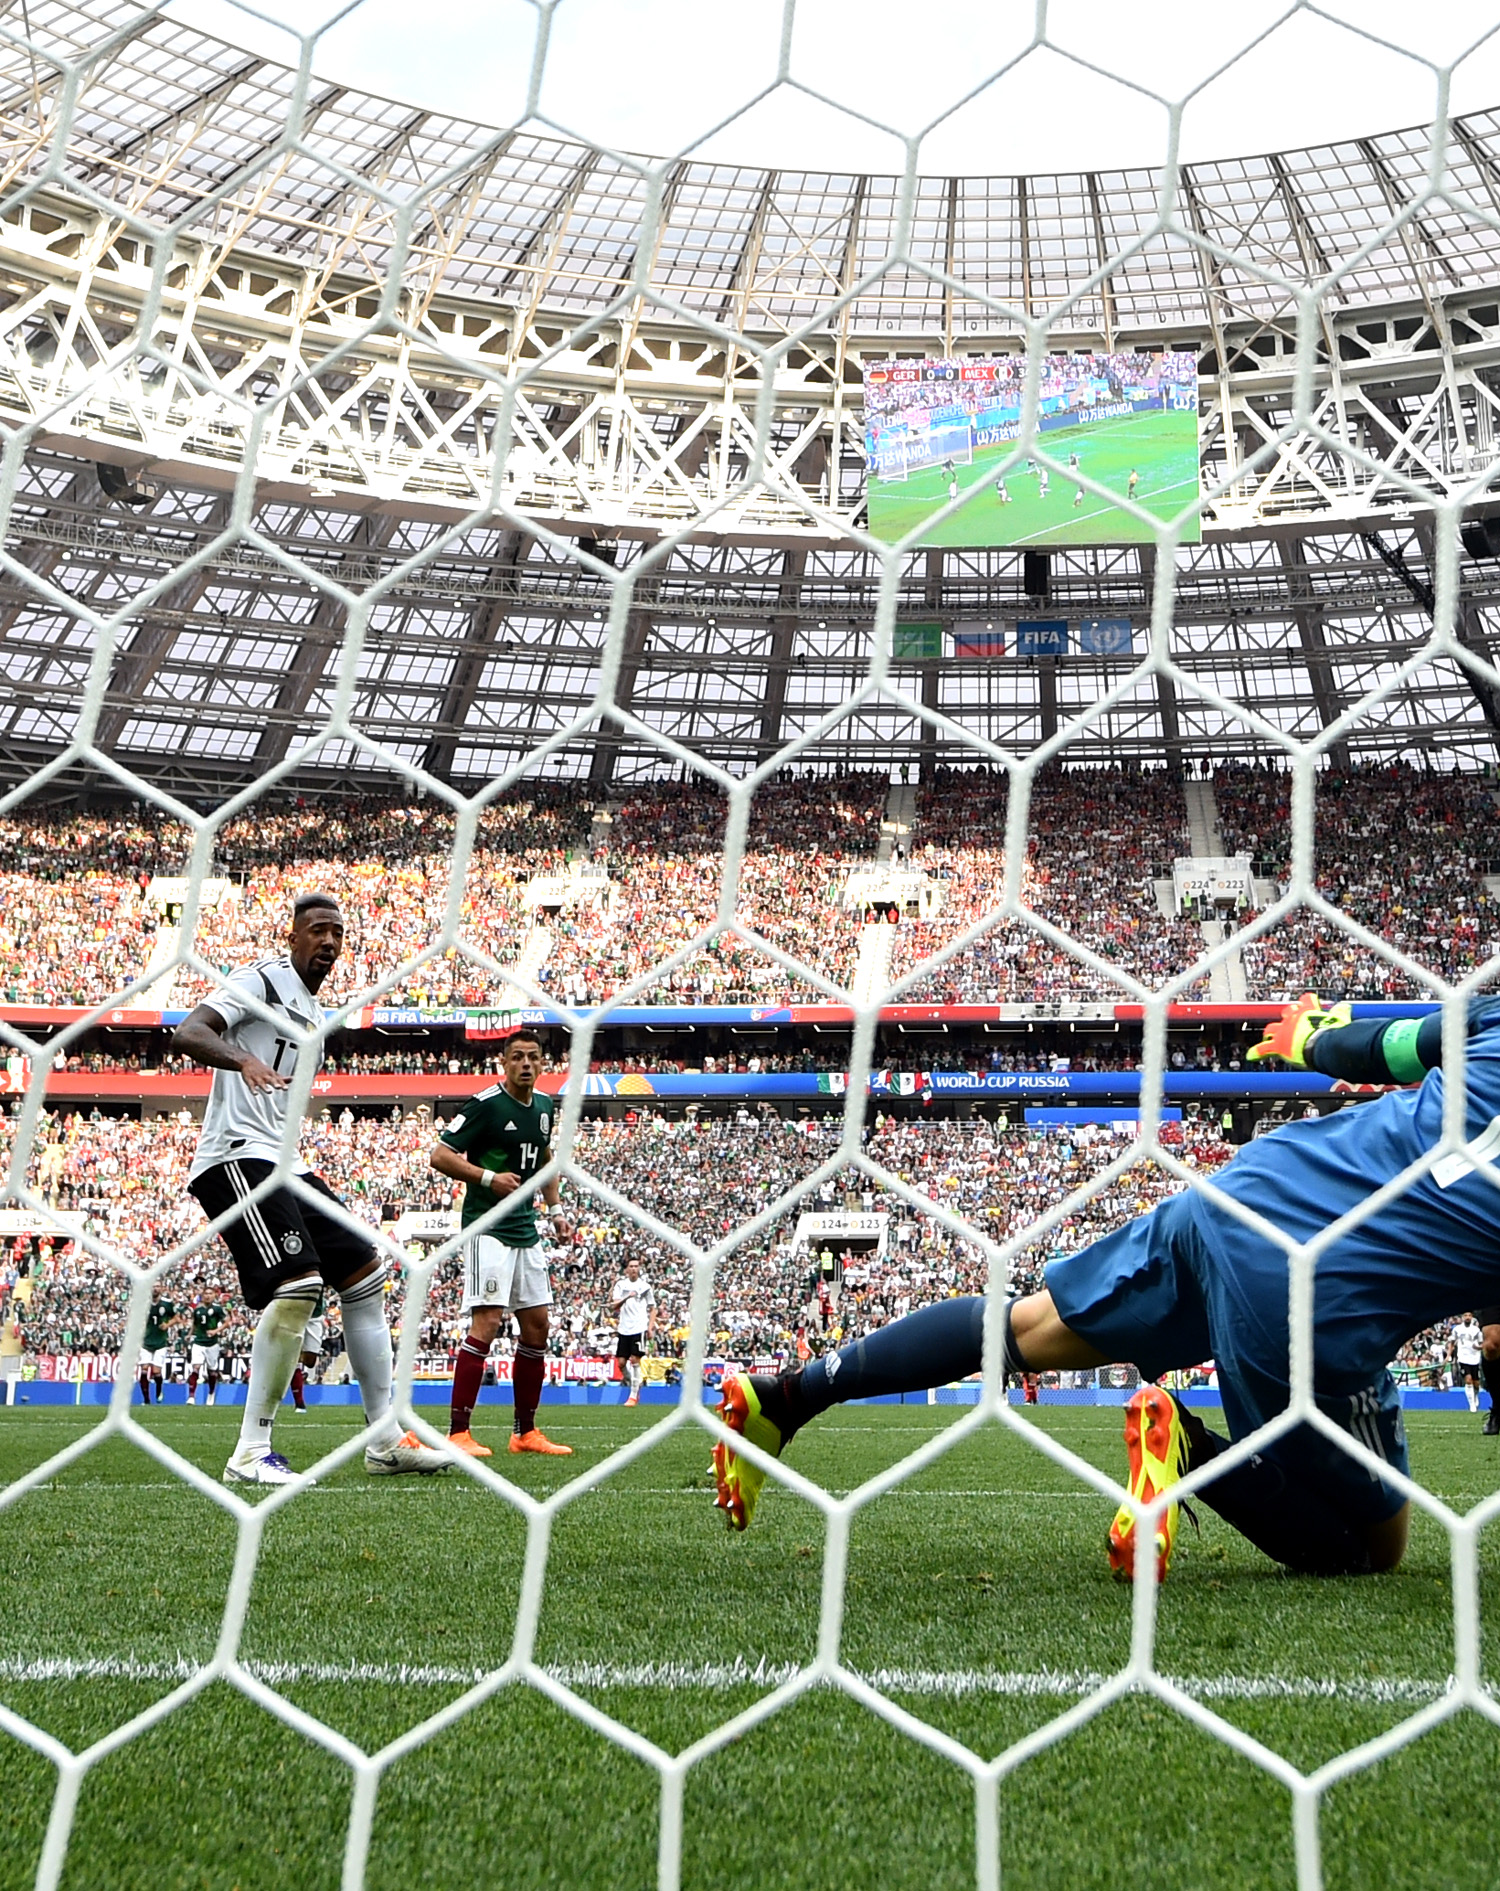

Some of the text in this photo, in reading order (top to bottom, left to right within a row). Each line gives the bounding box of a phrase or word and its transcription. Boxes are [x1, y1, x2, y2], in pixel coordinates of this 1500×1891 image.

[892, 370, 916, 381] GER
[926, 369, 954, 380] 0 0
[964, 368, 988, 379] MEX
[1106, 401, 1134, 416] WANDA
[895, 442, 932, 459] WANDA
[1024, 631, 1061, 644] FIFA
[1190, 880, 1245, 889] 224 223
[390, 1011, 417, 1023] FIFA
[419, 1011, 467, 1023] WORLD
[936, 1076, 986, 1088] WORLD
[987, 1076, 1016, 1088] CUP
[1018, 1076, 1070, 1088] RUSSIA
[519, 1142, 539, 1170] 14
[424, 1218, 444, 1229] 126
[821, 1219, 880, 1229] 124 123
[566, 1358, 614, 1378] Zwiesel
